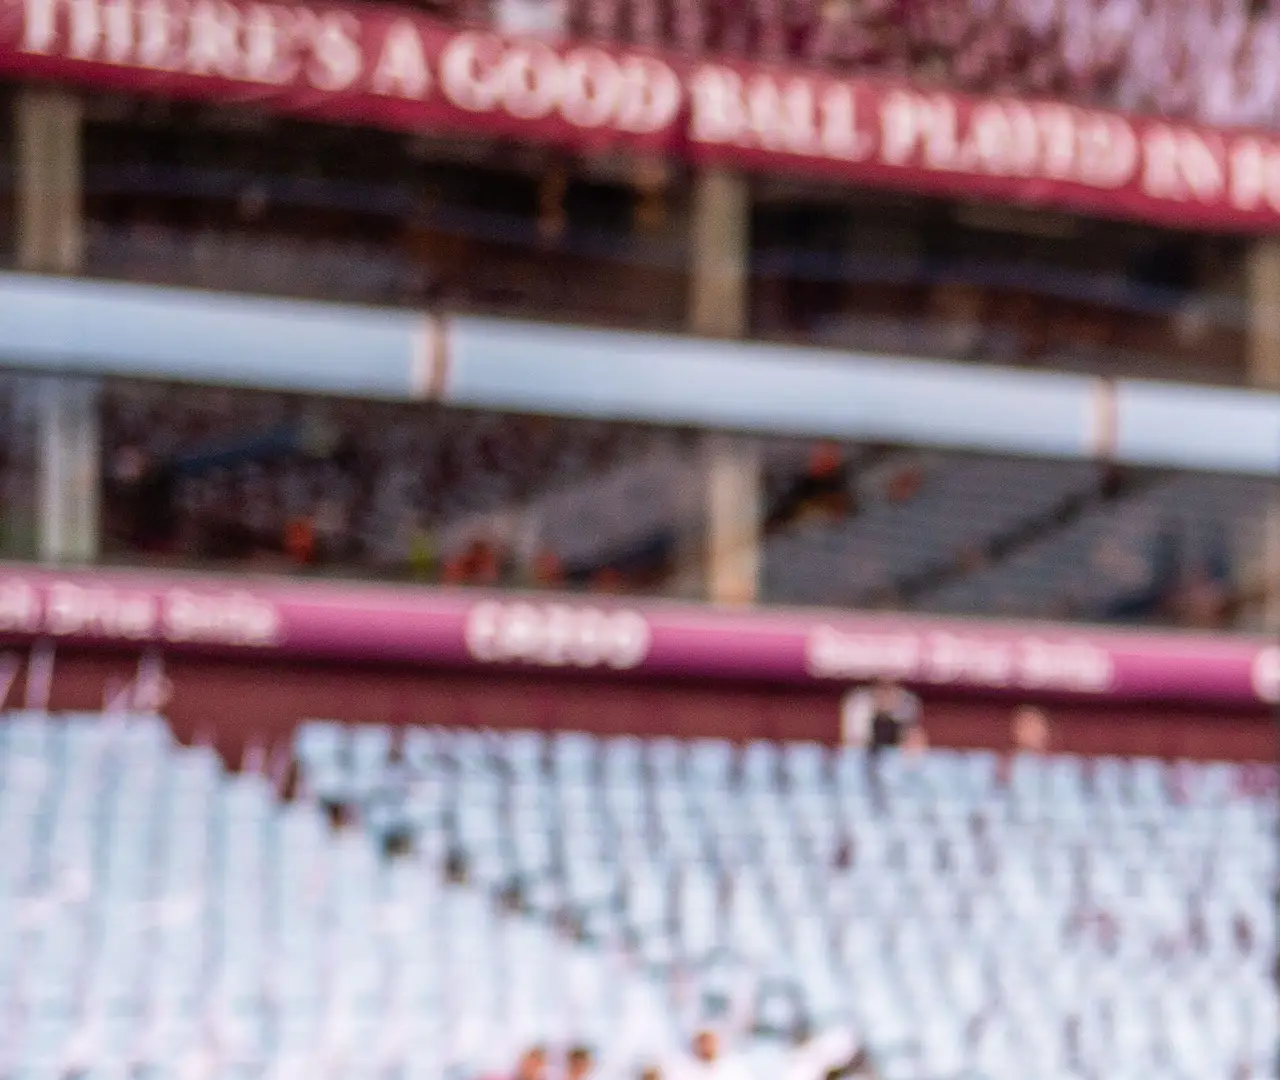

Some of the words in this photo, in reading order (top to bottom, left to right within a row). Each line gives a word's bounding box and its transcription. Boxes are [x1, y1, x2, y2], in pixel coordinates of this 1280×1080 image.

[371, 16, 432, 98] A
[440, 32, 682, 135] GOOD
[689, 64, 876, 163] BALL
[880, 92, 1139, 189] PLAYED
[1141, 124, 1226, 200] IN
